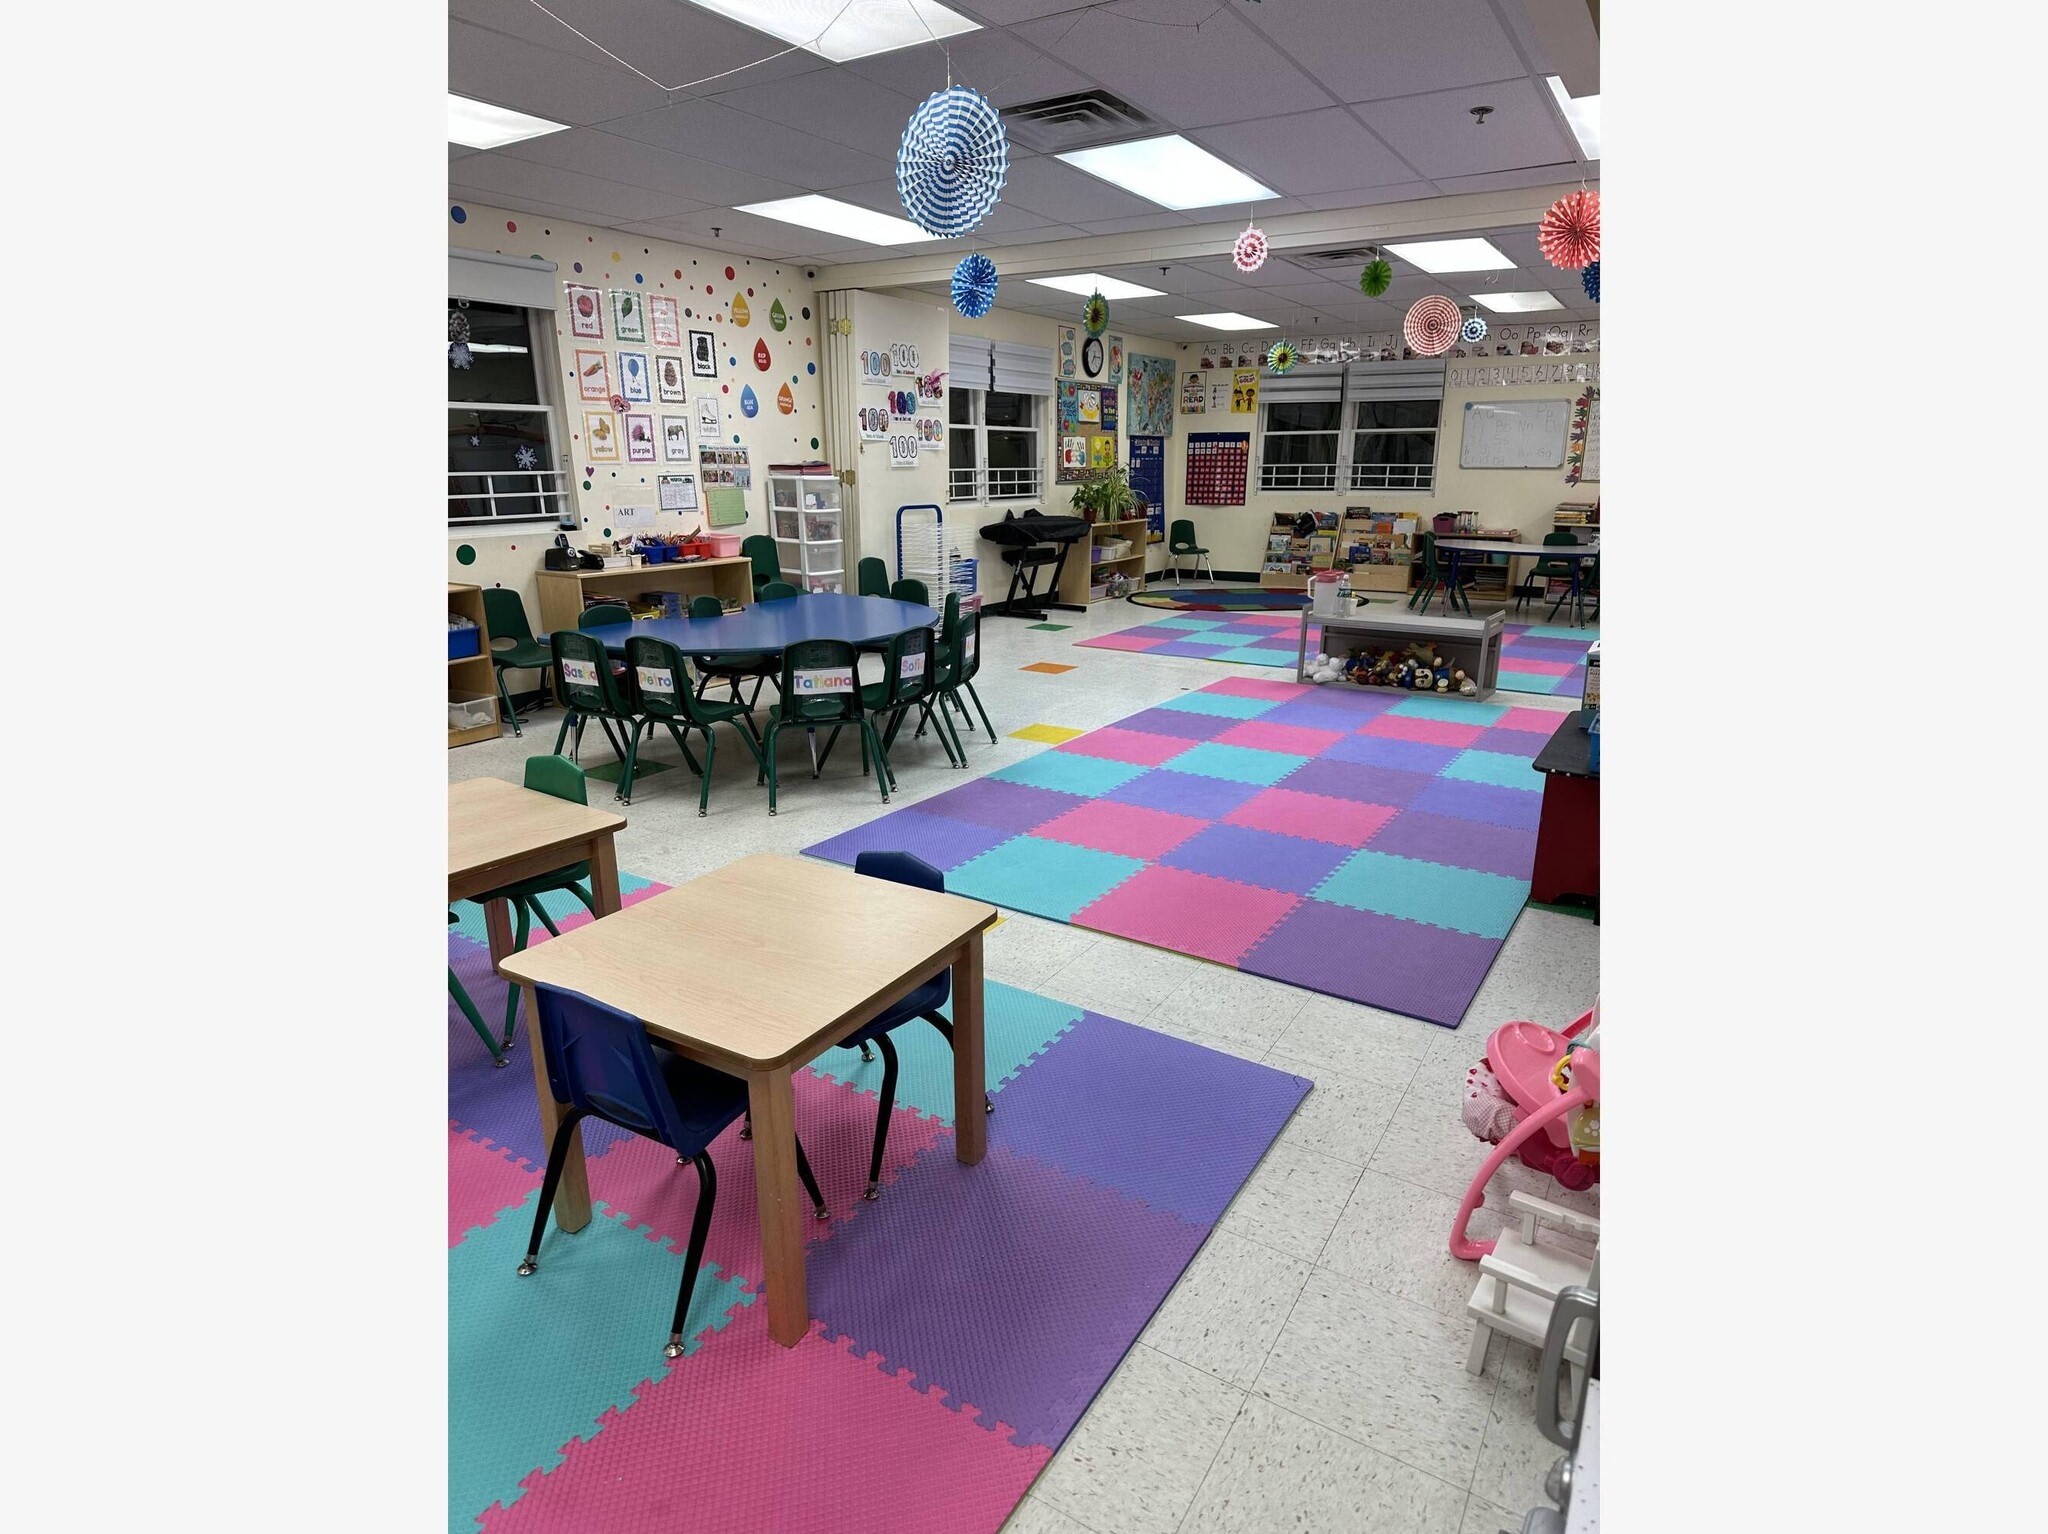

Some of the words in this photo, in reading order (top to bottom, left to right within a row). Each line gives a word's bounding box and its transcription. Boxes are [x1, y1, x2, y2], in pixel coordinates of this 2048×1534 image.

[1203, 344, 1216, 355] Aa
[1223, 344, 1234, 354] Bb
[1242, 342, 1254, 354] Cc
[1301, 338, 1314, 350] Ff
[1320, 338, 1336, 350] Gg
[1386, 334, 1399, 350] Jj
[1500, 328, 1518, 340] Oo
[1527, 327, 1540, 343] Pp
[1579, 324, 1592, 336] Rr
[697, 362, 711, 370] black
[861, 351, 890, 376] 100
[891, 344, 920, 368] 100
[1493, 368, 1500, 379] 3
[1506, 367, 1514, 378] 4
[1536, 366, 1542, 377] 6
[1551, 366, 1559, 377] 7
[888, 391, 916, 414] 100
[859, 408, 889, 432] 100
[916, 420, 943, 441] 100
[890, 436, 917, 458] 100
[618, 508, 635, 516] ART
[640, 671, 672, 687] Petro
[794, 674, 853, 689] Tatiana
